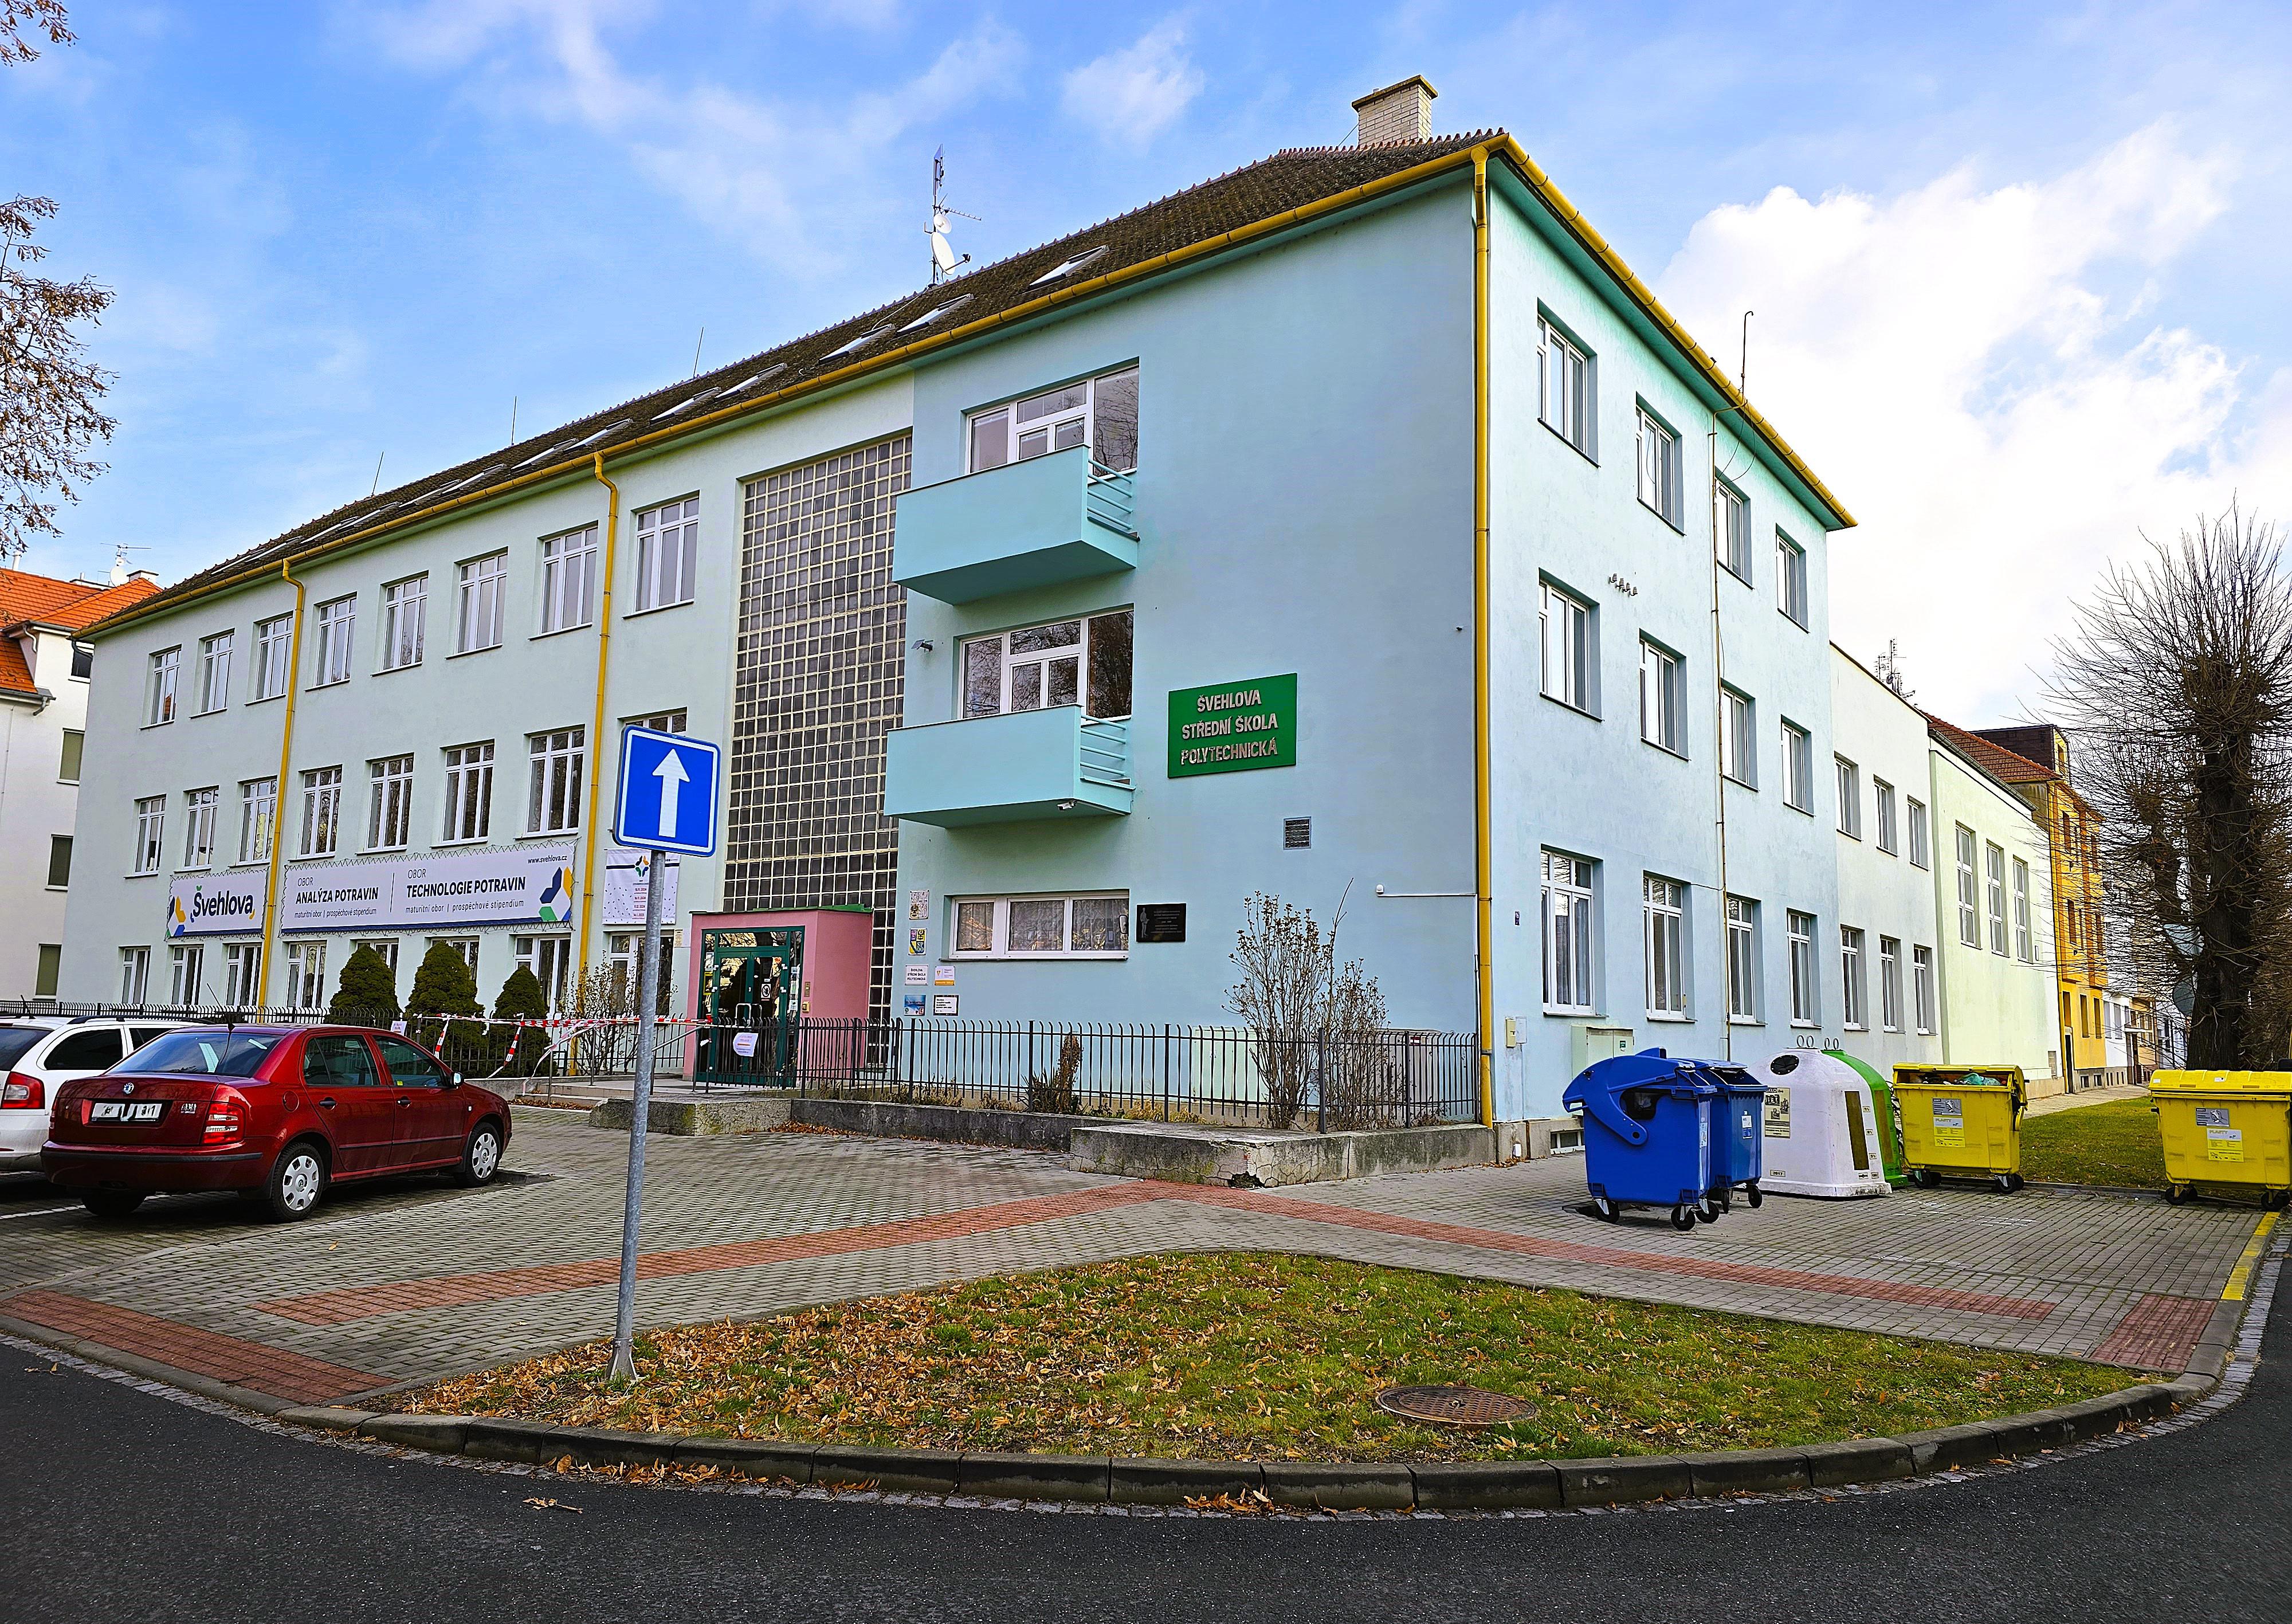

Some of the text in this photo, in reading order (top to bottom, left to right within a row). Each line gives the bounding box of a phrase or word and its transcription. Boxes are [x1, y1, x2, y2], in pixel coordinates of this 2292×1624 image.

[1197, 689, 1262, 712] ŠVEHLOVA
[1182, 713, 1278, 739] STŘEDNÍ ŠKOLA
[1181, 737, 1278, 765] POLYTECHNICKÁ
[528, 855, 567, 864] www.svehlova.cz
[297, 877, 313, 886] OBOR
[408, 868, 426, 878] OBOR
[407, 876, 526, 897] TECHNOLOGIE POTRAVIN
[193, 885, 253, 917] Švehlova
[296, 887, 379, 904] ANALÝZA POTRAVIN
[353, 907, 376, 917] stipendium
[406, 899, 524, 913] maturitní obor prospěchové stipendium
